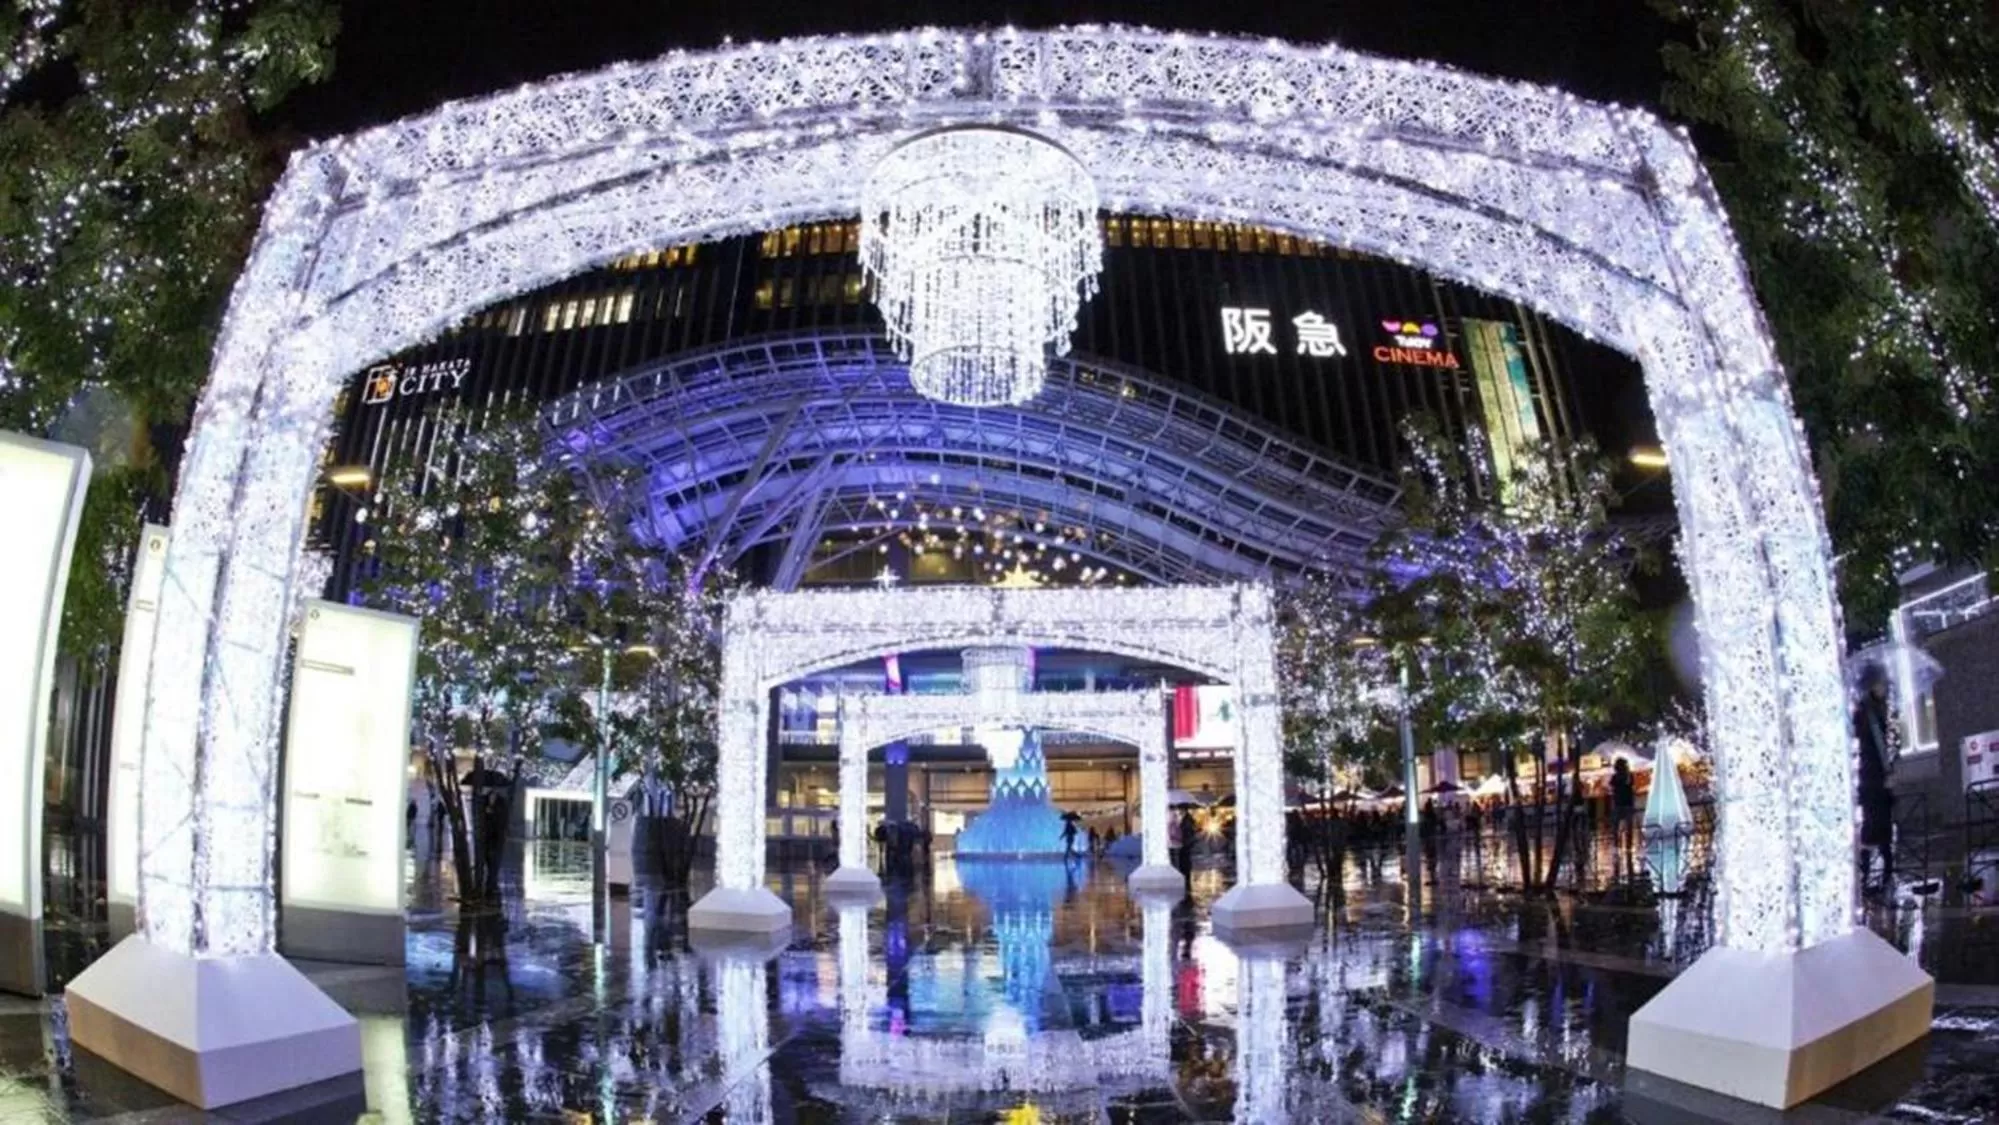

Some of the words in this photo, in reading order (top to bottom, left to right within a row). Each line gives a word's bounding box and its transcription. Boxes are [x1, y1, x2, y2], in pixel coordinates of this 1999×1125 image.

[1221, 307, 1347, 357] 阪急
[1374, 346, 1460, 369] CINEMA
[400, 368, 470, 395] CITY
